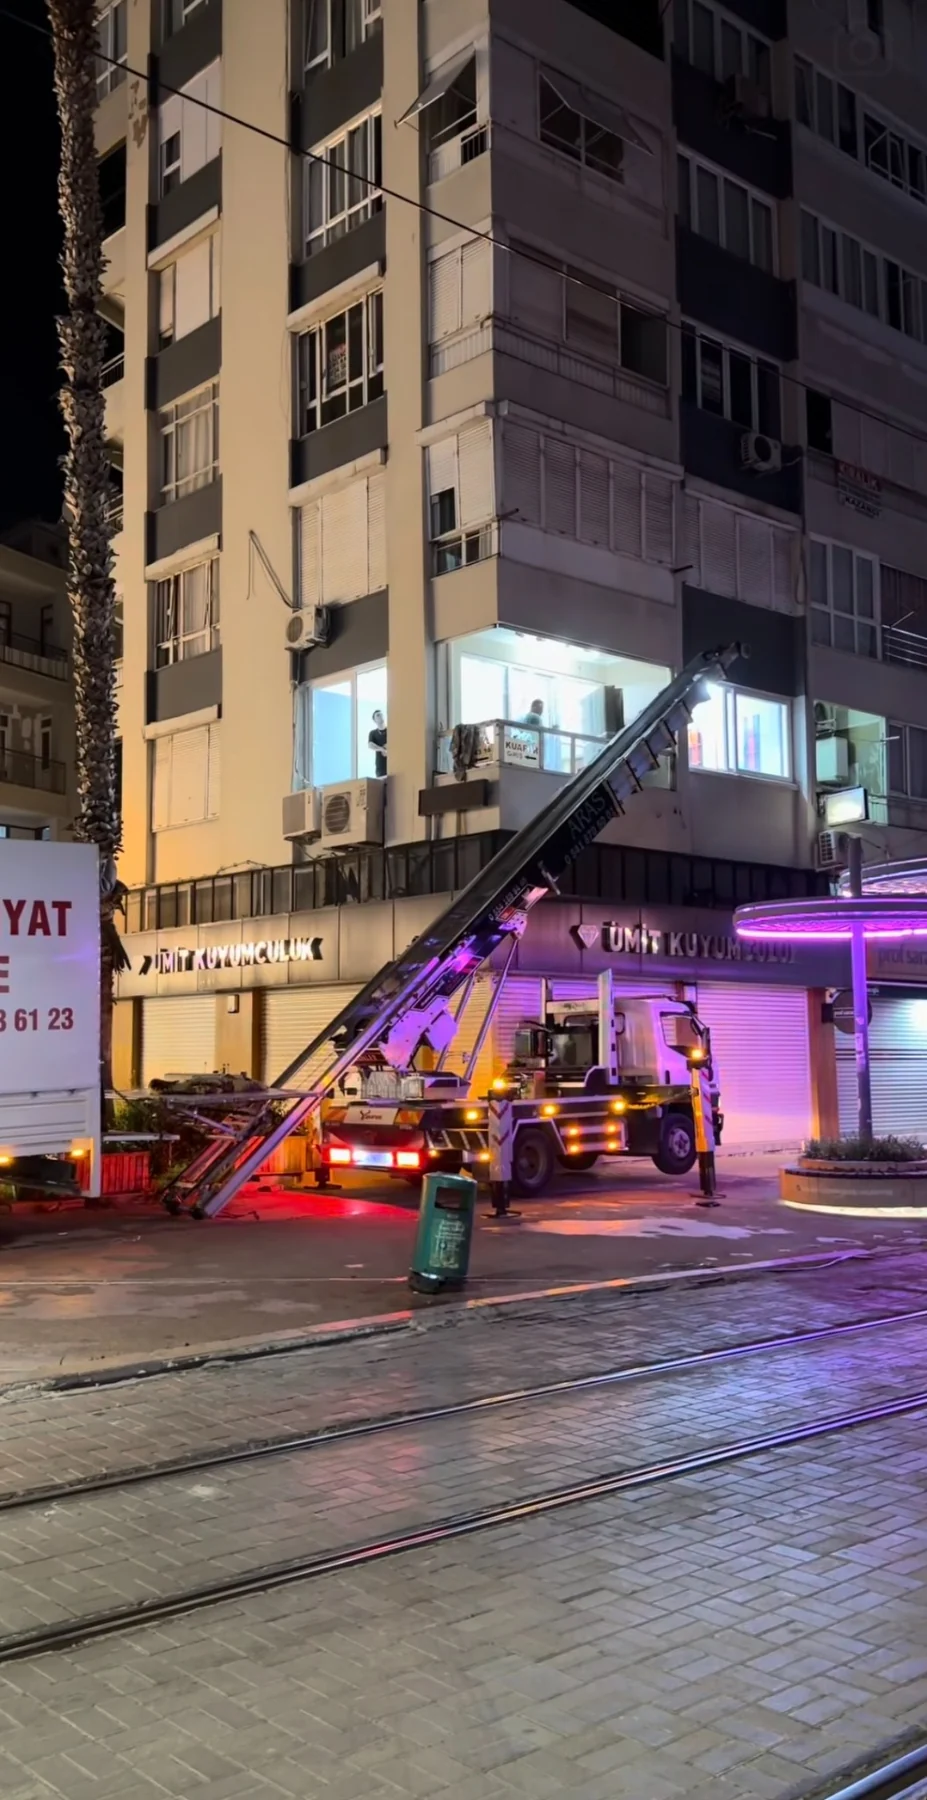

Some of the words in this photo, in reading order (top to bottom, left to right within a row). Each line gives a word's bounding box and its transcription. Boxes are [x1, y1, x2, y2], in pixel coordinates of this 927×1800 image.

[568, 791, 605, 840] ARAS
[193, 937, 315, 971] KUYUMCULUK
[607, 920, 661, 955] ÜMİT
[14, 1008, 38, 1031] 61
[48, 1007, 74, 1030] 23
